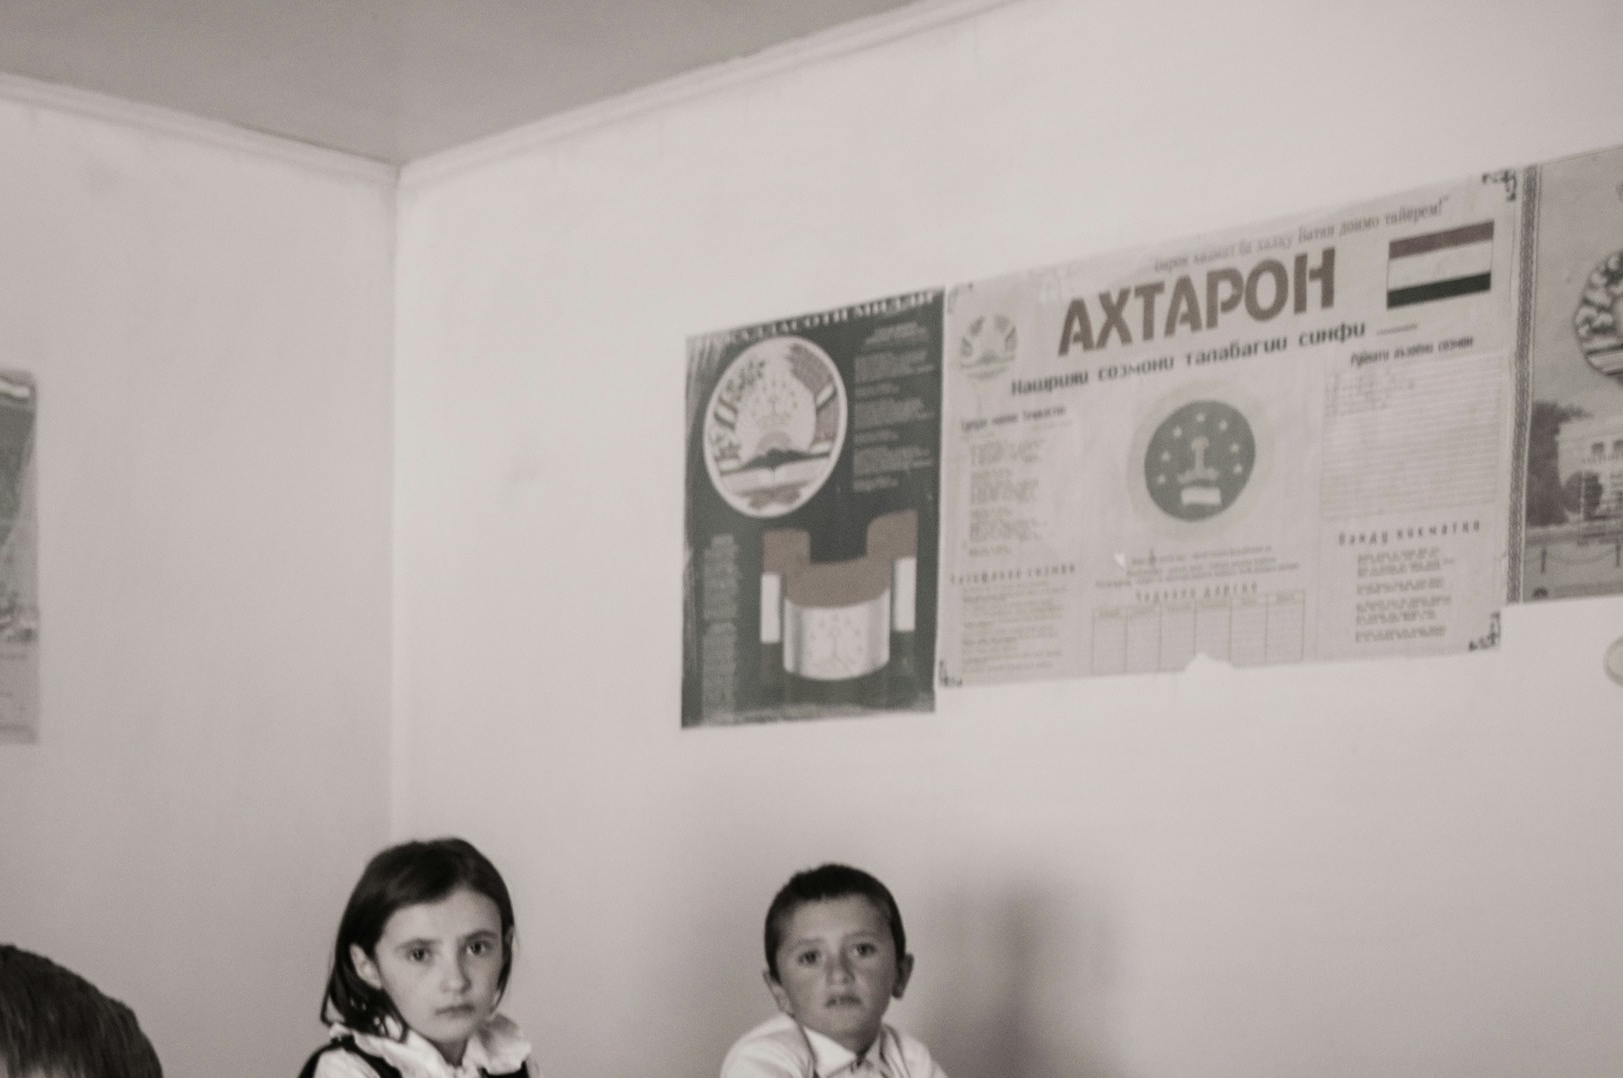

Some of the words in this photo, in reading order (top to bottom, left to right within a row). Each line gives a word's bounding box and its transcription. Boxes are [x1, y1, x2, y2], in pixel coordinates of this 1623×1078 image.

[1057, 247, 1337, 358] АХТАРОН
[1098, 356, 1175, 381] созмони
[1182, 336, 1288, 367] талабагии
[1297, 320, 1367, 348] синфи
